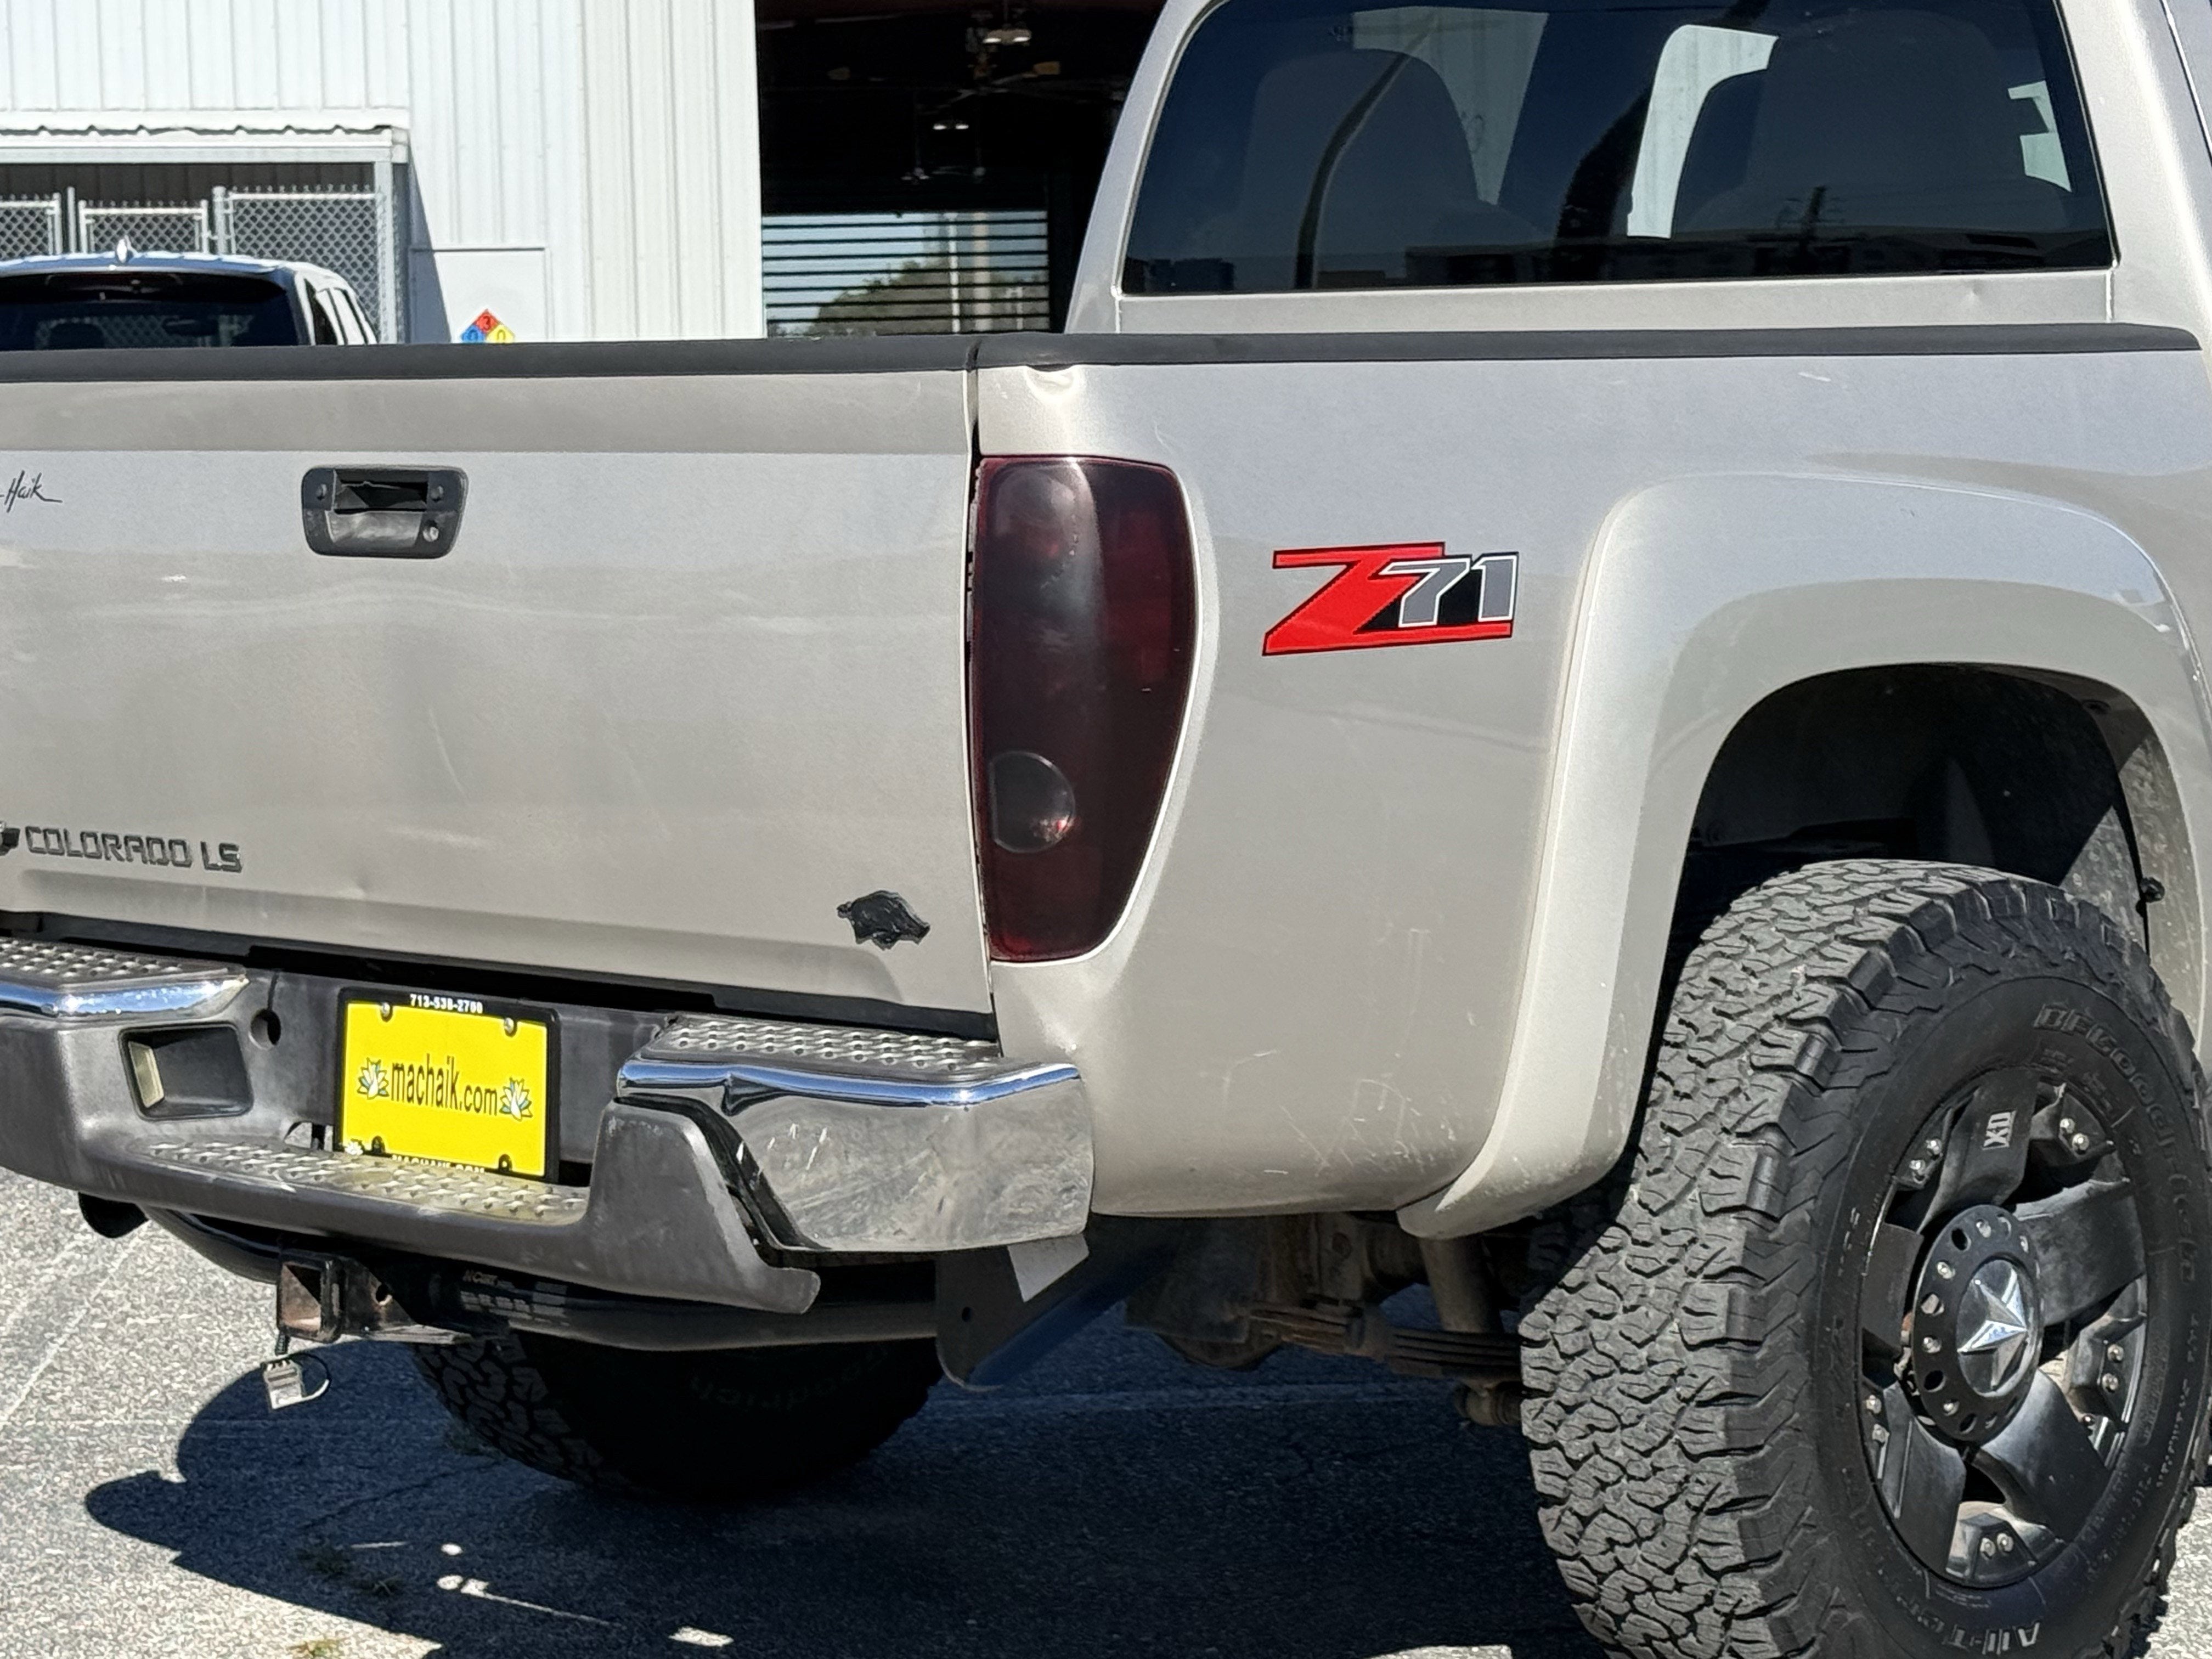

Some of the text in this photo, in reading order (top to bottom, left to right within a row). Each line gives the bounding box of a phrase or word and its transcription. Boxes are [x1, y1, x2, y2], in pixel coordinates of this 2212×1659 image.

[483, 315, 491, 331] 3
[4, 470, 63, 513] Haik
[1262, 541, 1519, 656] Z71
[25, 826, 242, 873] COLORADO LS
[391, 1052, 498, 1116] machaik.com
[1982, 1110, 2017, 1151] XD
